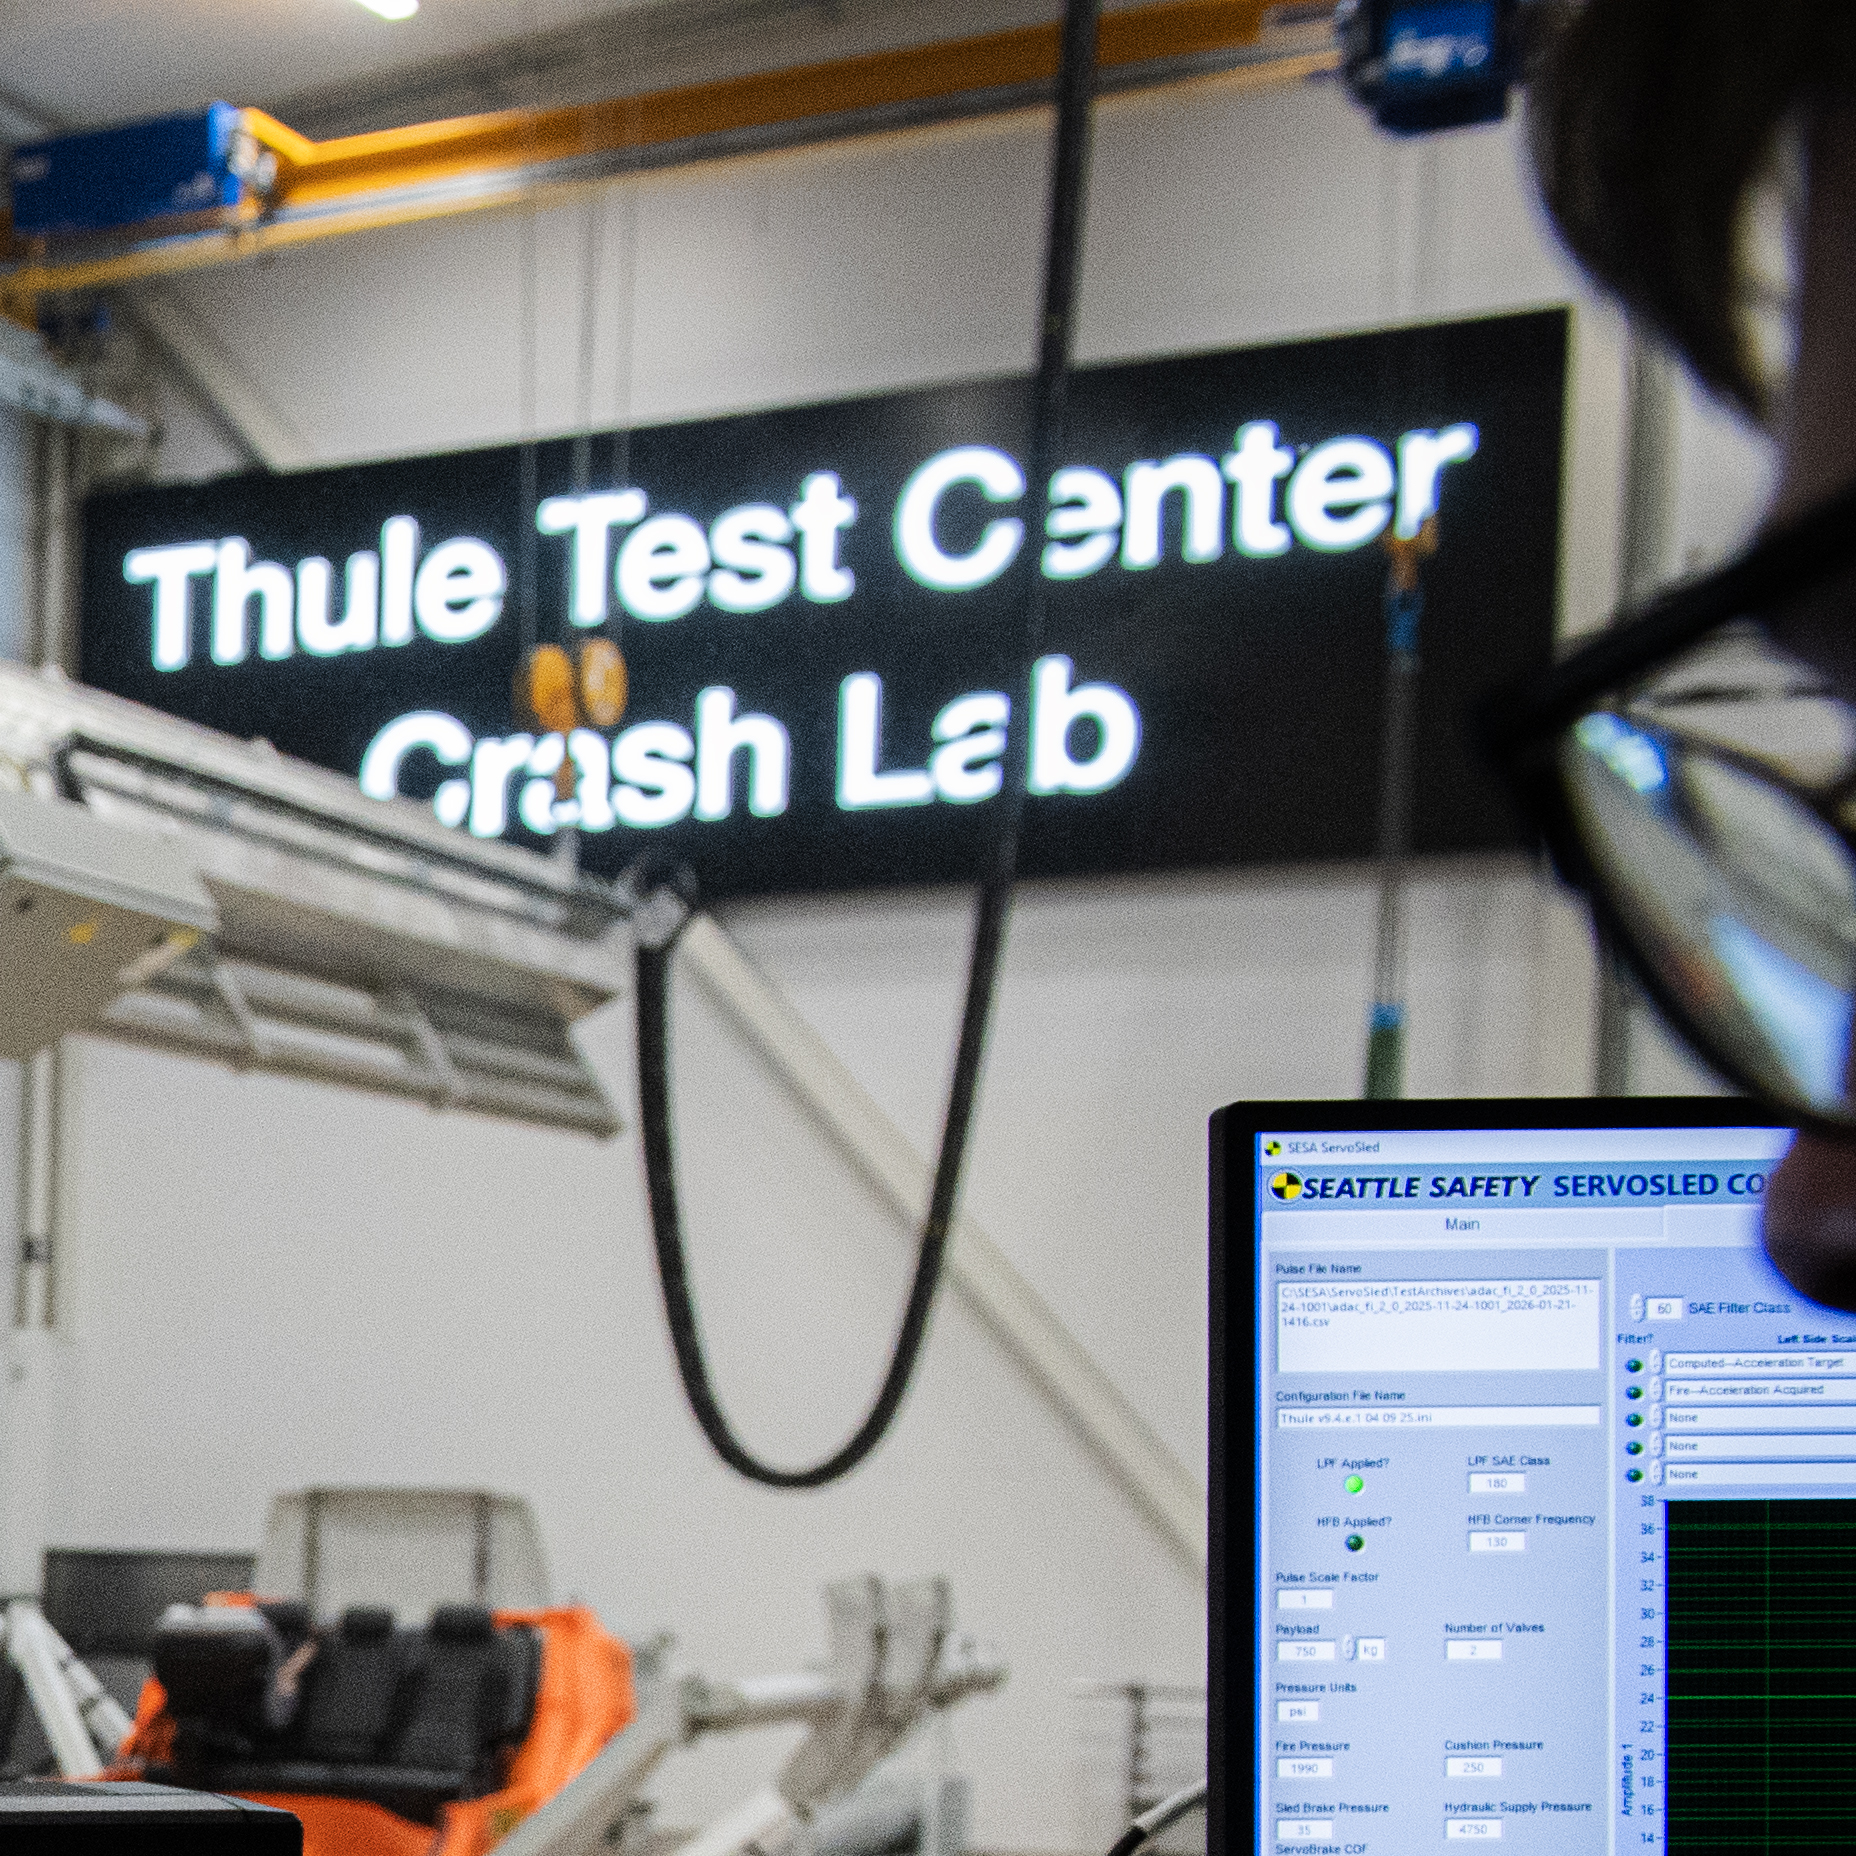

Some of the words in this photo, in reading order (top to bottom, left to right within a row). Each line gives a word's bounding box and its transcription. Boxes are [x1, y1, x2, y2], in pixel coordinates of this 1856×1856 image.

[123, 516, 508, 673] Thule
[538, 473, 857, 627] Test
[893, 419, 1479, 591] Center
[359, 685, 789, 835] Crash
[837, 654, 1140, 809] Lab
[1288, 1142, 1318, 1154] SESA
[1322, 1141, 1380, 1154] ServoSled
[1303, 1177, 1419, 1199] SEATTLE
[1430, 1175, 1540, 1198] SAFETY
[1553, 1174, 1718, 1197] SERVOSLED
[1445, 1217, 1480, 1231] Main
[1690, 1303, 1714, 1314] SAE
[1718, 1302, 1750, 1314] Filter
[1754, 1302, 1790, 1314] Class
[1277, 1390, 1353, 1402] Configuration
[1375, 1390, 1406, 1401] Name
[1670, 1413, 1697, 1423] None
[1277, 1624, 1319, 1636] Payload
[1445, 1623, 1486, 1633] Number
[1505, 1623, 1544, 1633] Valves
[1363, 1644, 1377, 1658] kg
